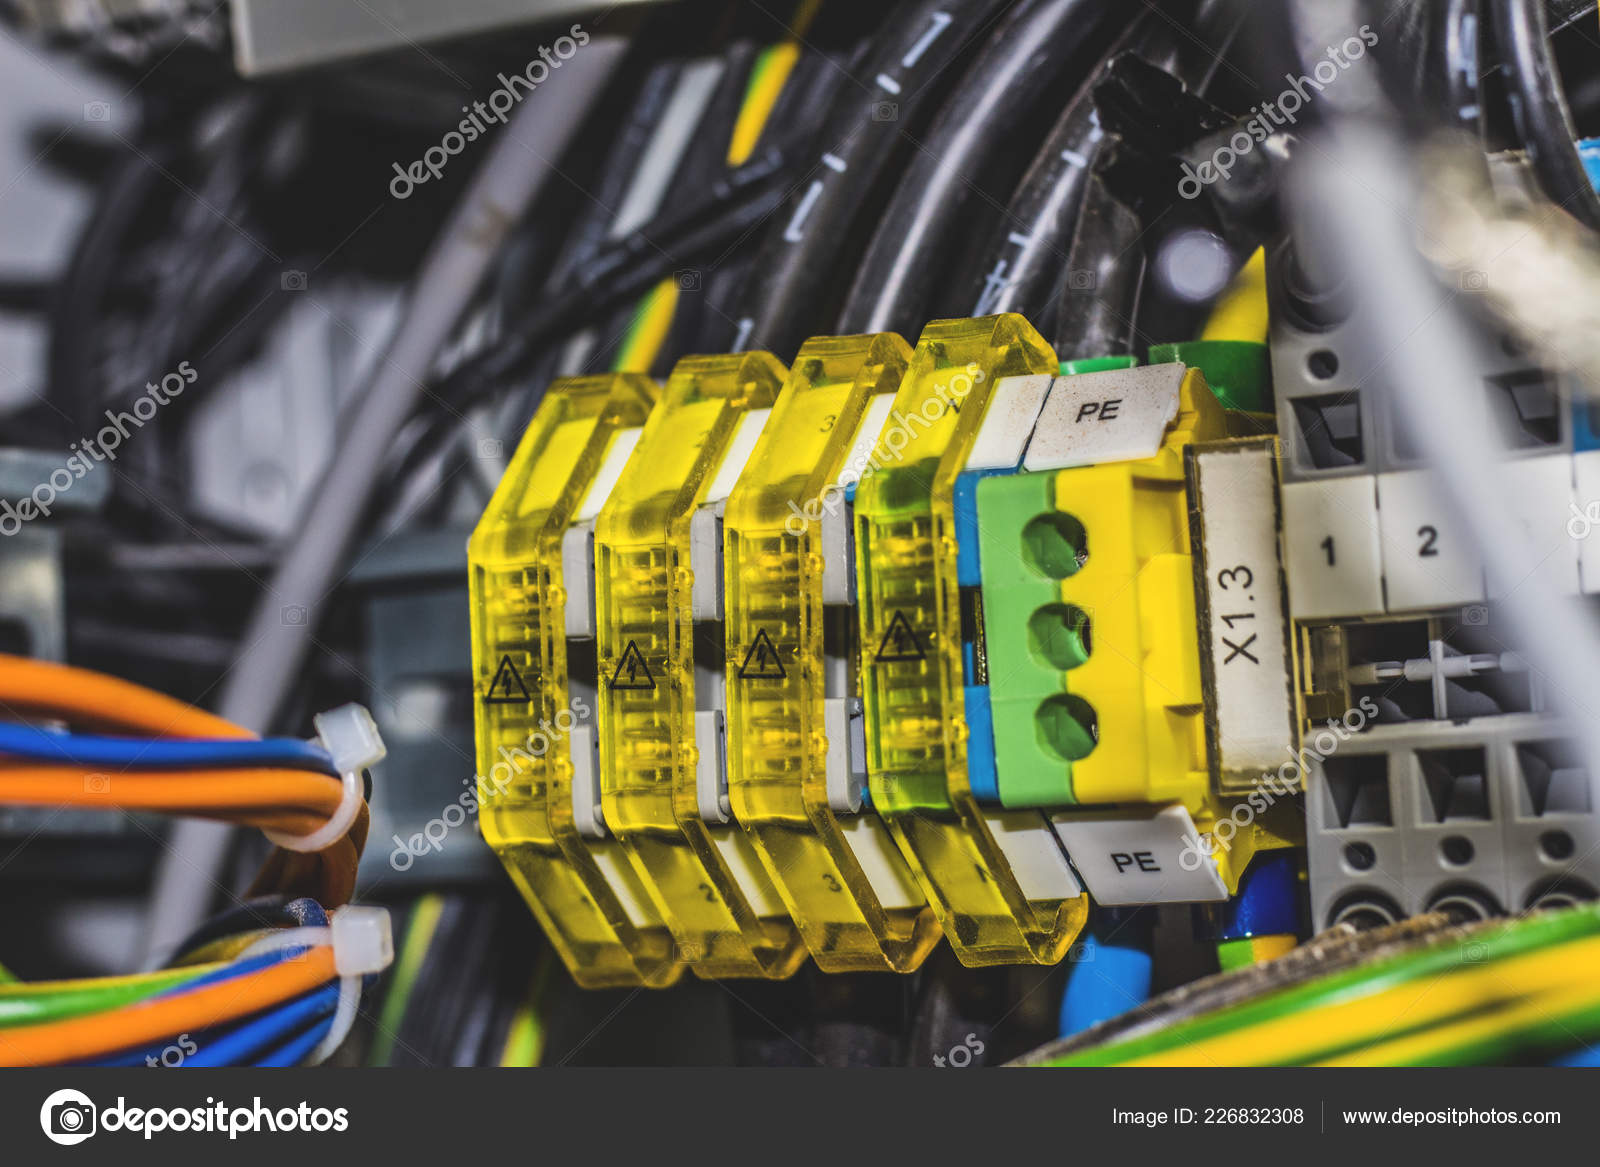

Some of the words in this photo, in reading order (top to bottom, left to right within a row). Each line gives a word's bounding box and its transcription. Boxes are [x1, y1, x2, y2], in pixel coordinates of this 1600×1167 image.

[1075, 399, 1123, 423] PE
[1321, 535, 1336, 567] 1
[1417, 525, 1439, 557] 2
[1217, 565, 1260, 666] X1.3
[1110, 851, 1161, 874] PE
[822, 873, 842, 893] 3
